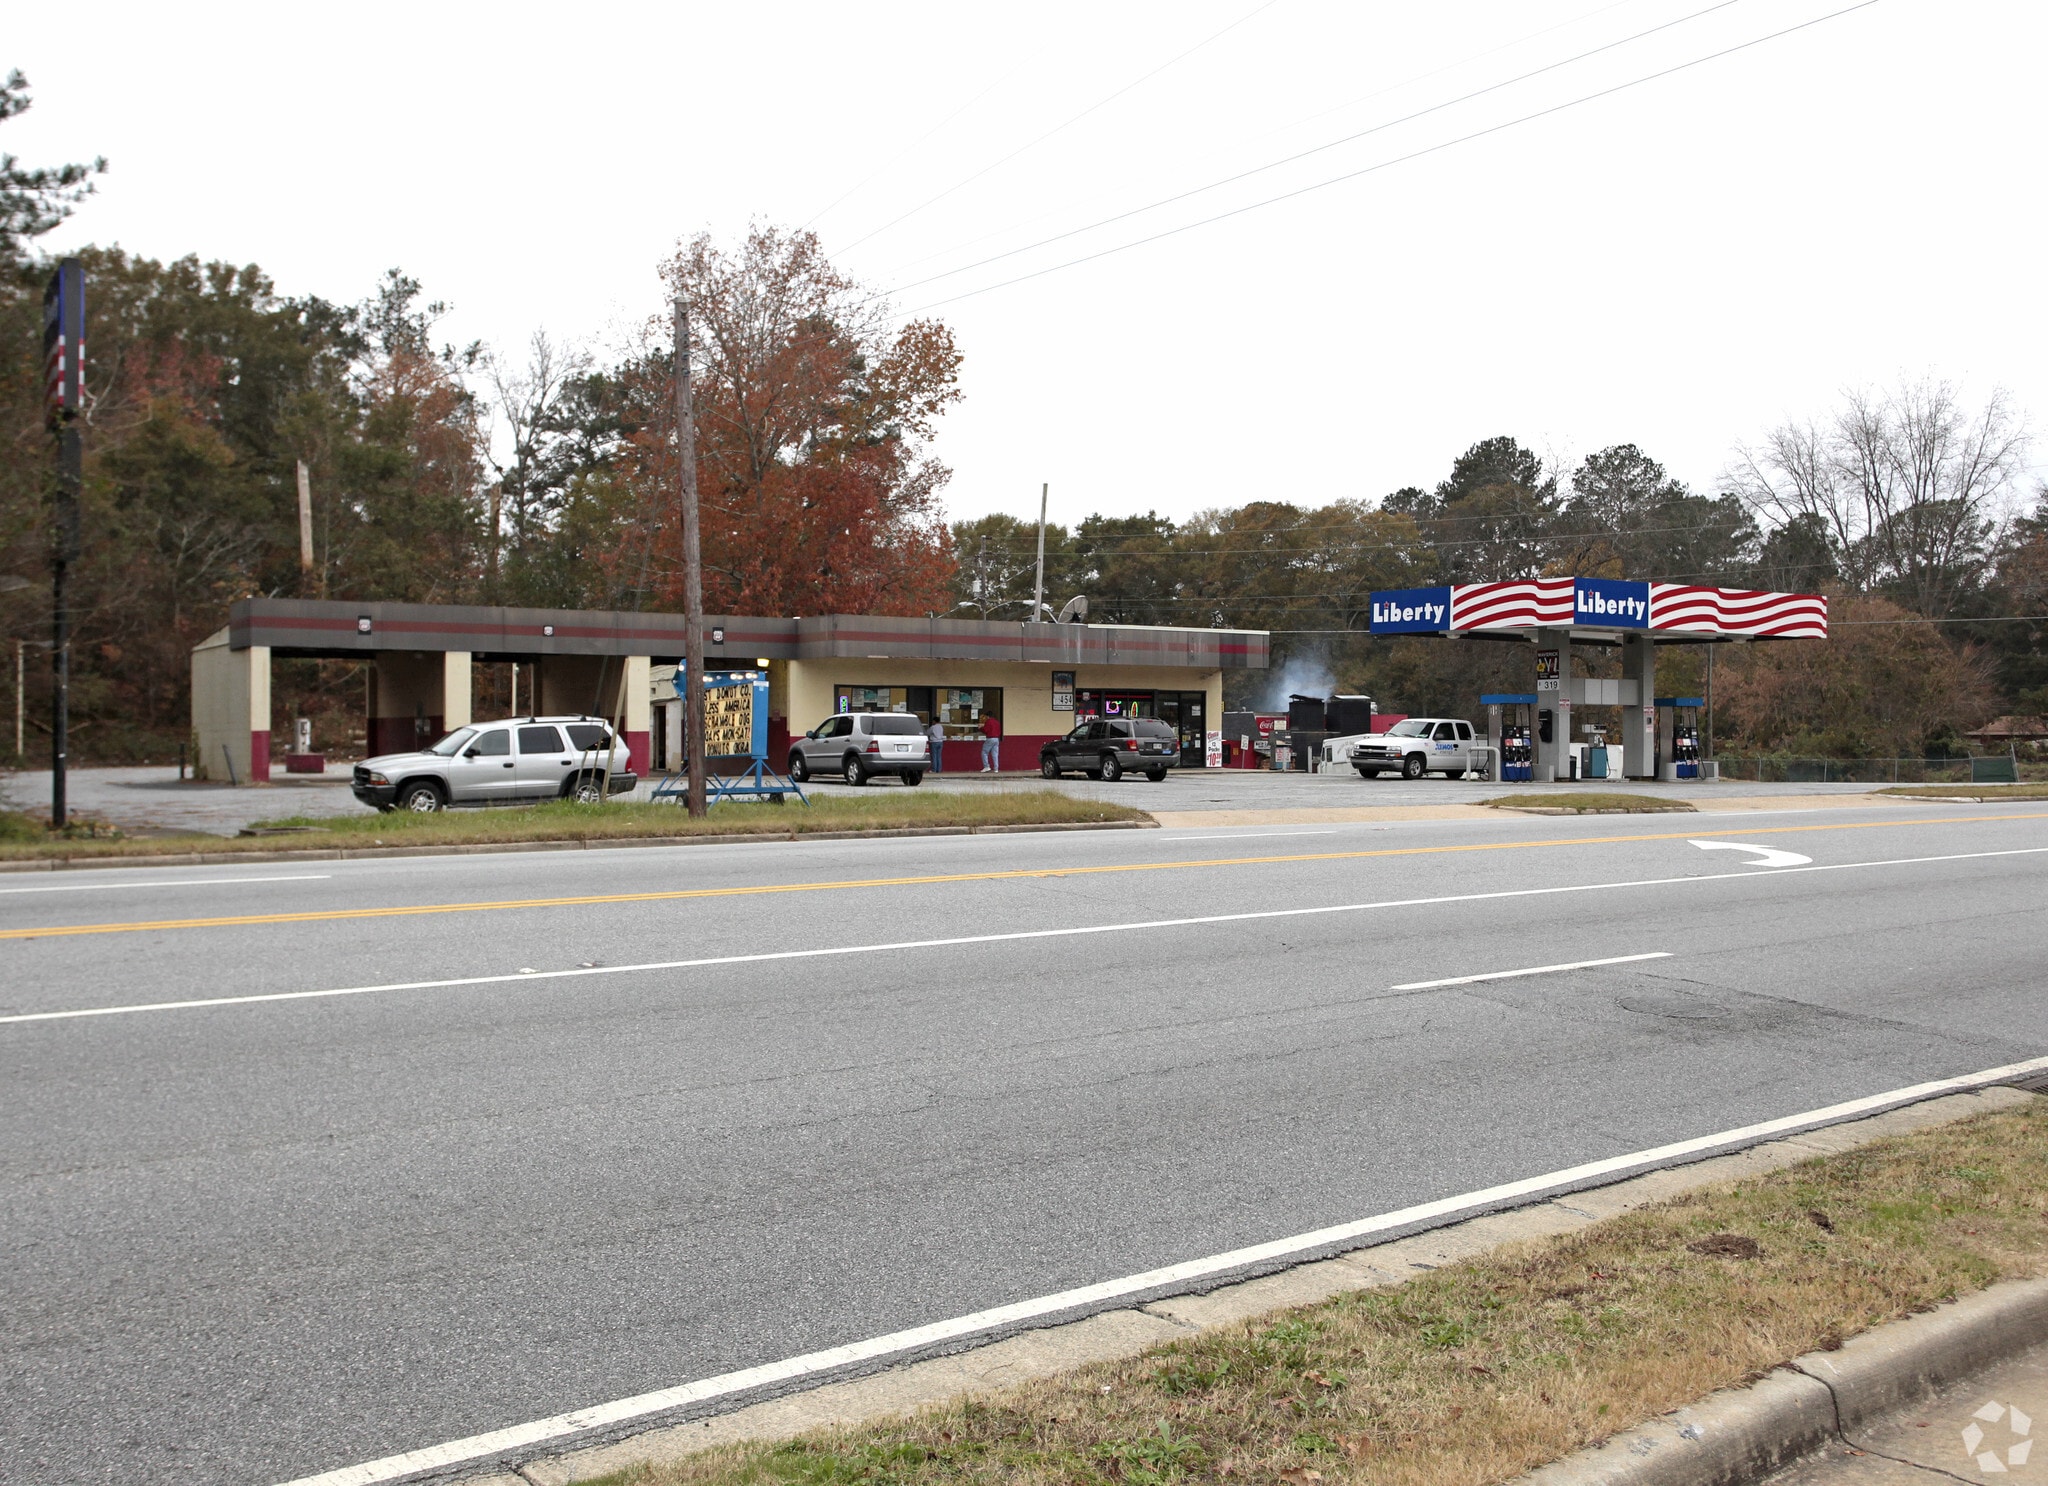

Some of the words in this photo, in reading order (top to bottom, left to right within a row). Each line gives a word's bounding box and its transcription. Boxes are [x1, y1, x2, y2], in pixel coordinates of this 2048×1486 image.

[1373, 601, 1444, 623] Liberty
[1578, 589, 1645, 620] Liberty
[1544, 681, 1558, 689] 319
[704, 702, 719, 714] LESS
[725, 699, 750, 712] AMERICA
